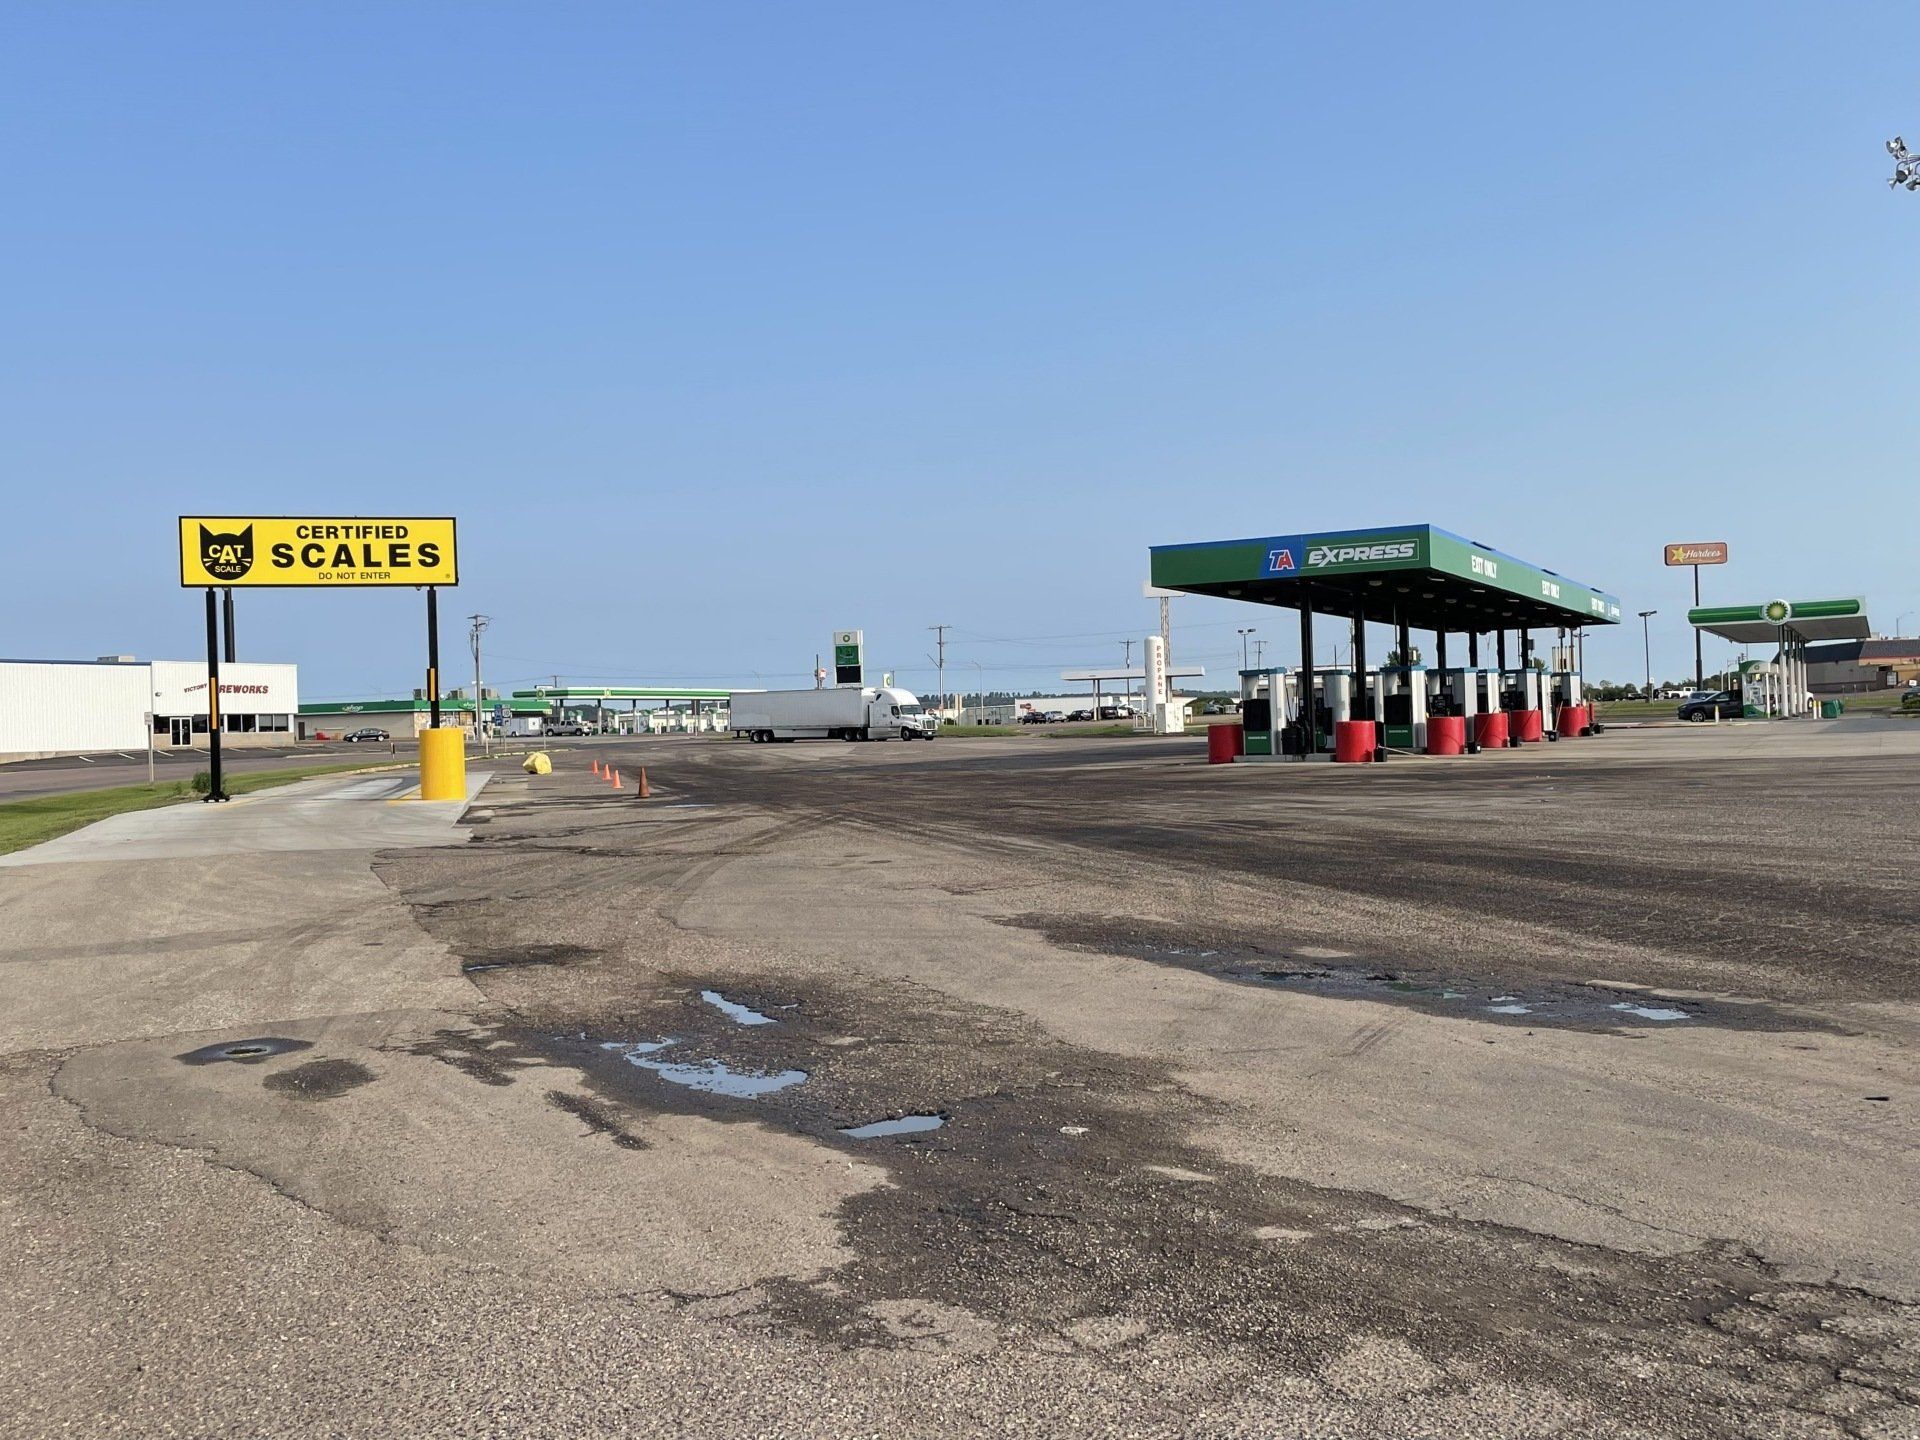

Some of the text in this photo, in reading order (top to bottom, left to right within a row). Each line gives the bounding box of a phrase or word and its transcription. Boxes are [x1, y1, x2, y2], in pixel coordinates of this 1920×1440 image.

[296, 525, 409, 540] CERTIFIED
[208, 544, 245, 564] CAT
[271, 542, 441, 569] SCALES
[1269, 543, 1415, 571] TA EXPRESS
[214, 565, 242, 574] SCALE
[318, 571, 391, 580] DO NOT ENTER
[183, 683, 269, 694] VICTORY REWORKS
